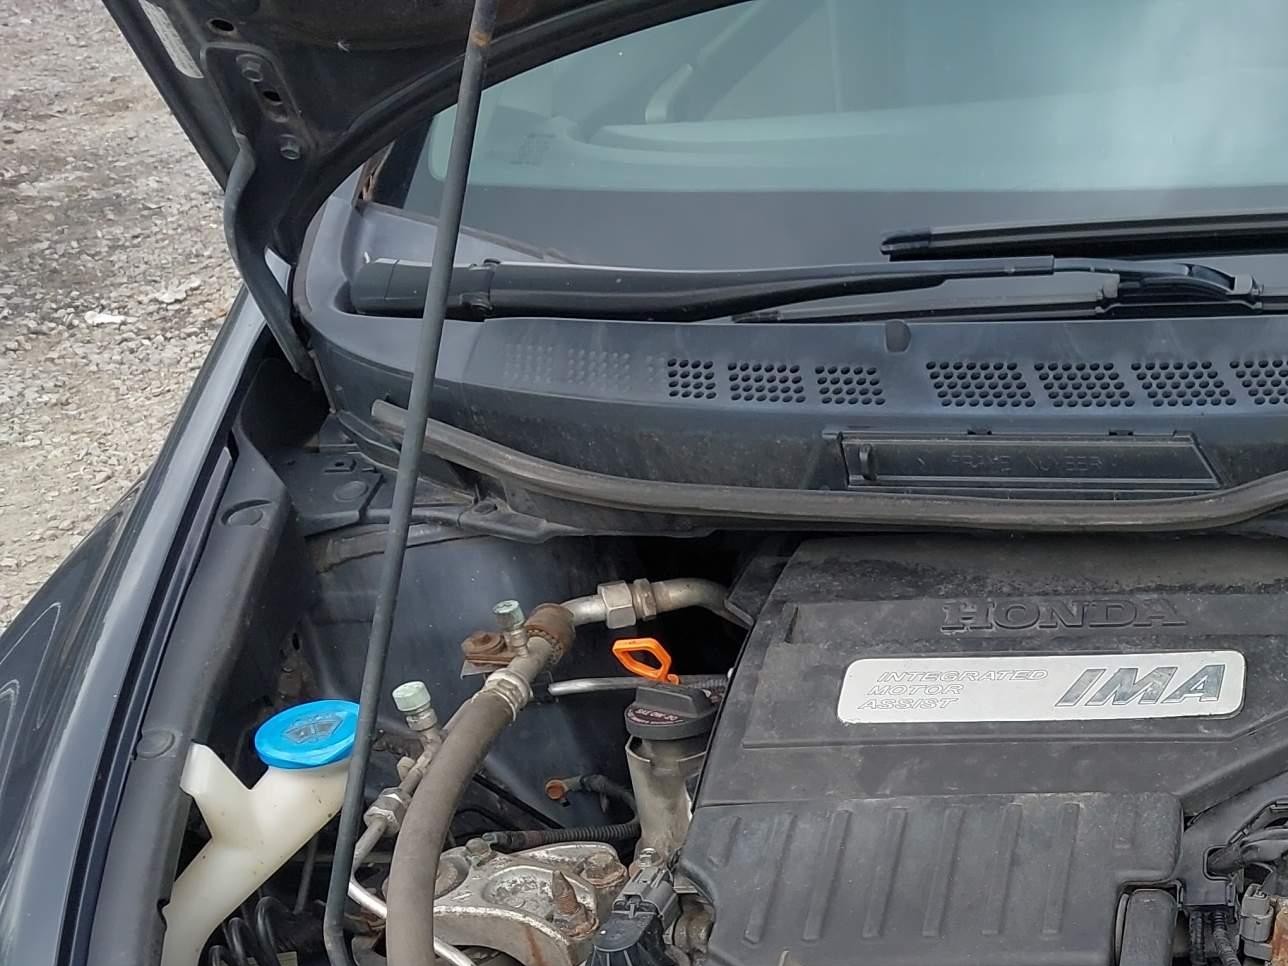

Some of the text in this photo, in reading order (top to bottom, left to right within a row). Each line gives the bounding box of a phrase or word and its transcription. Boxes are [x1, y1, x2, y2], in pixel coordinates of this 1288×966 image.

[941, 599, 1188, 631] HONDA
[876, 668, 1049, 683] INTEGRATED
[868, 684, 965, 697] MOTOR
[1054, 665, 1226, 707] IMA
[857, 697, 960, 711] ASSIST
